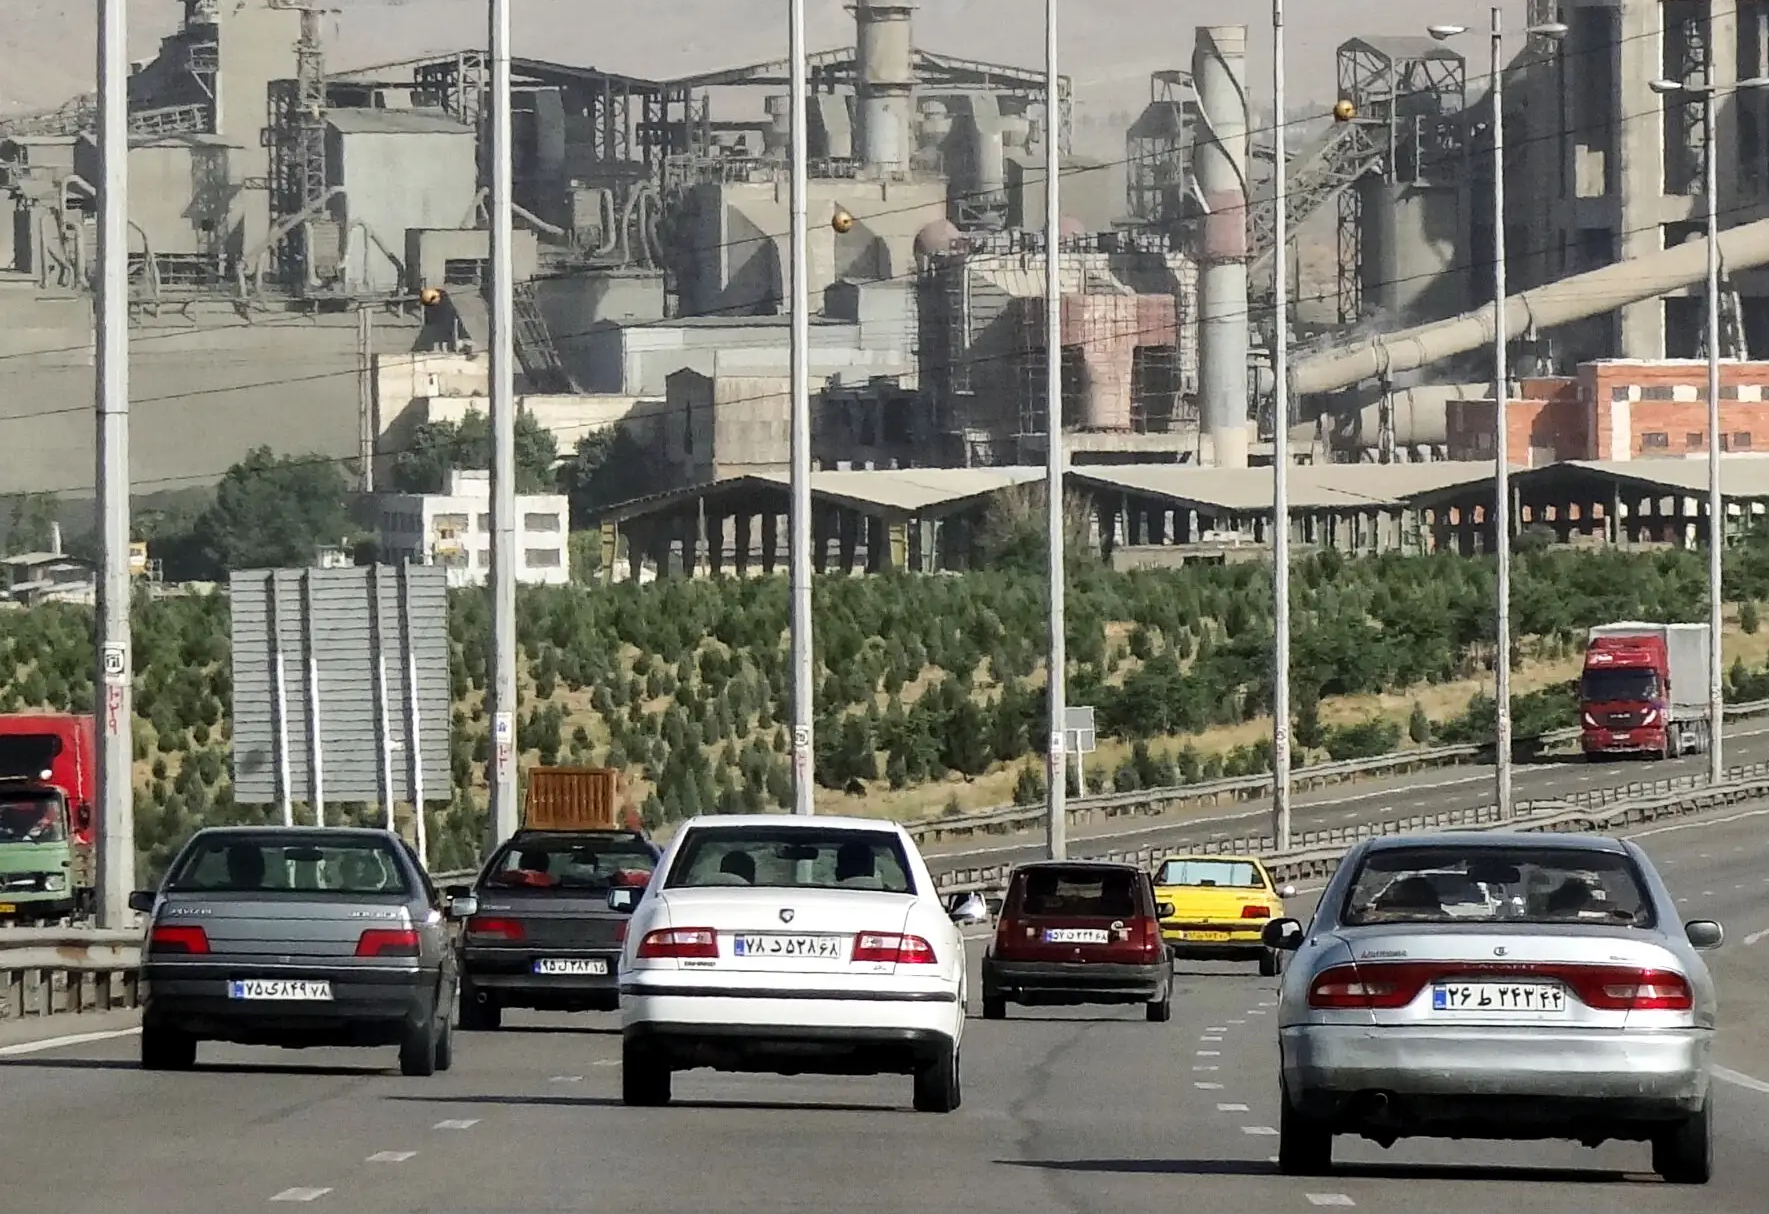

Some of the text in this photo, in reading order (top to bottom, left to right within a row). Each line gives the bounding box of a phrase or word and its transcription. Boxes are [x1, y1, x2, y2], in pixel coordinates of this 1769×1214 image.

[1448, 986, 1472, 1007] ۲۶
[1498, 986, 1535, 1008] ۳۴۳
[1540, 990, 1562, 1009] ۴۴
